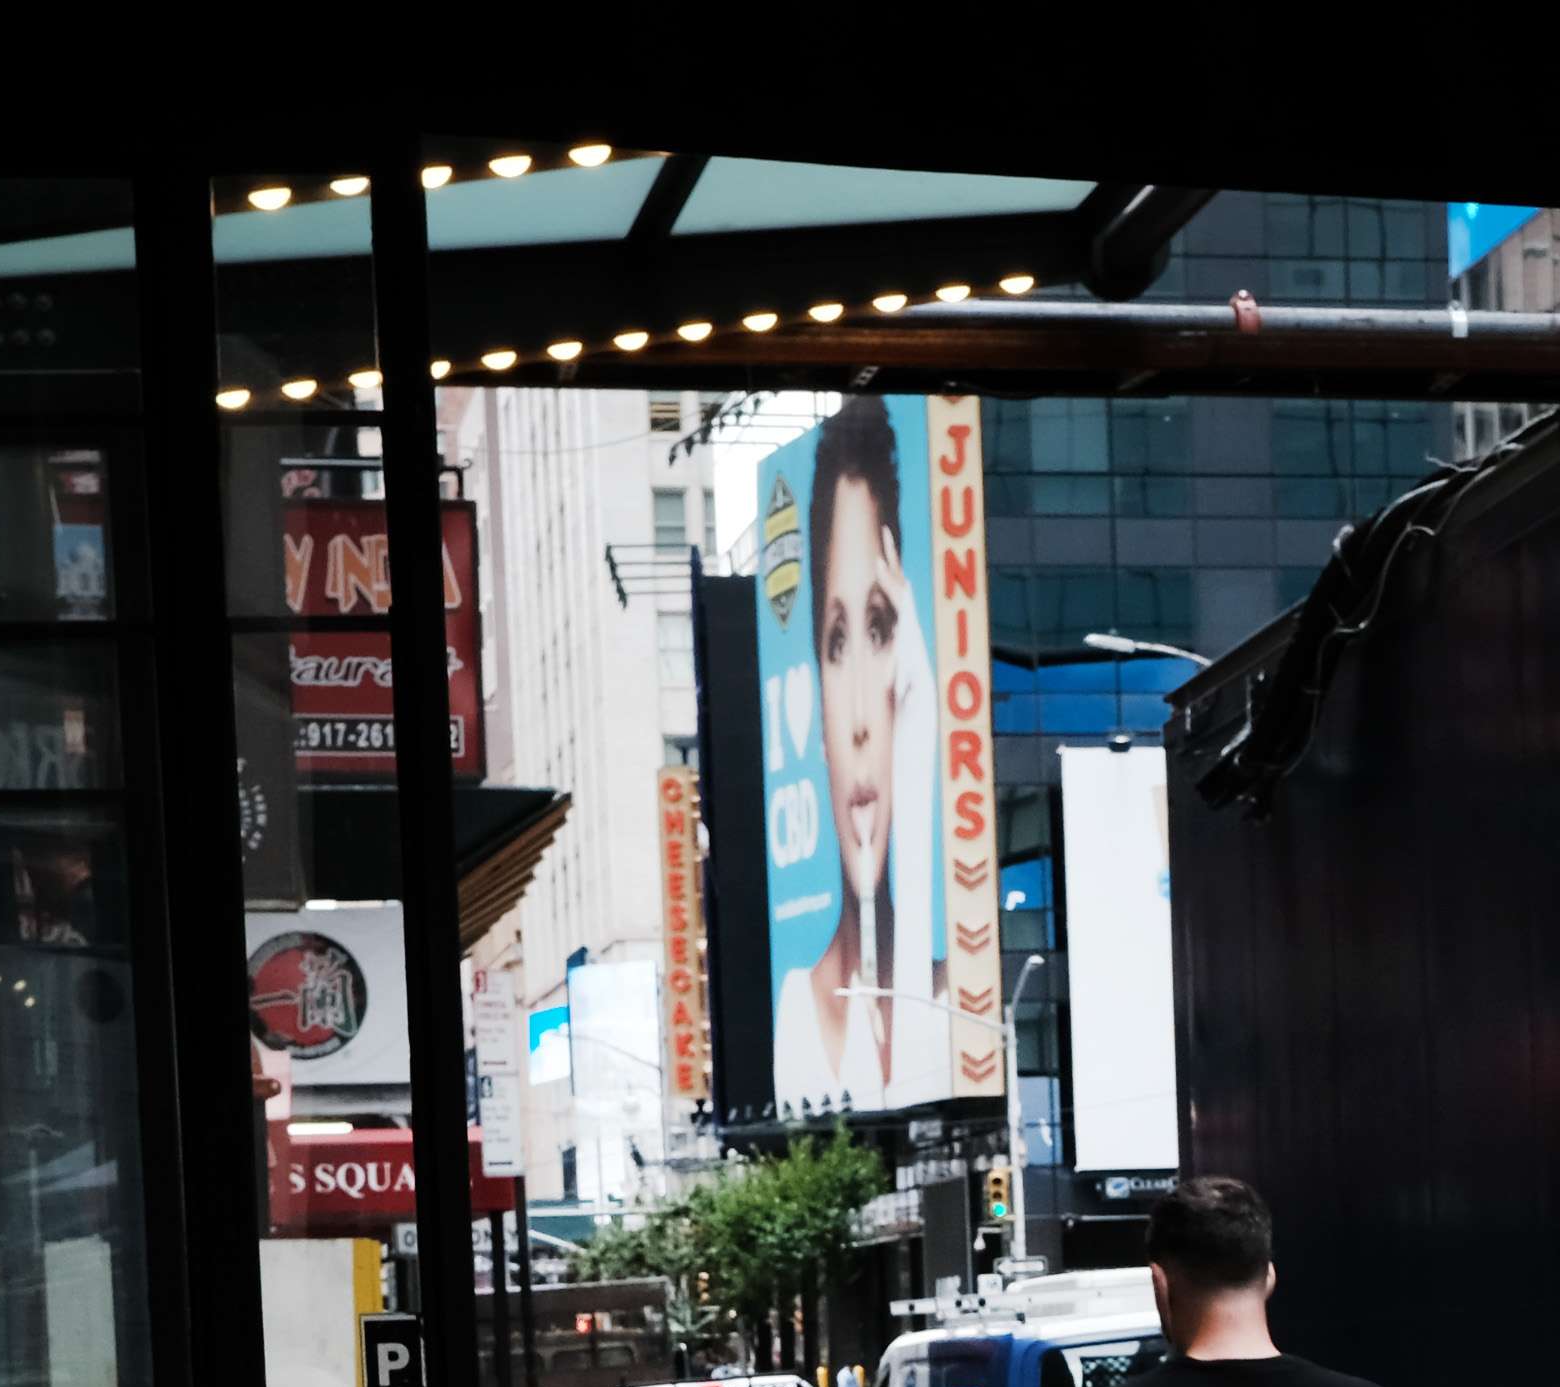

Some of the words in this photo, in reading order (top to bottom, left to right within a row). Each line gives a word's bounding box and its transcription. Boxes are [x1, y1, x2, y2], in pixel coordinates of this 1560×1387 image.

[765, 675, 785, 773] I
[937, 421, 986, 843] JUNIORS
[769, 777, 819, 869] CBD
[661, 777, 694, 1092] CHEESECAKE
